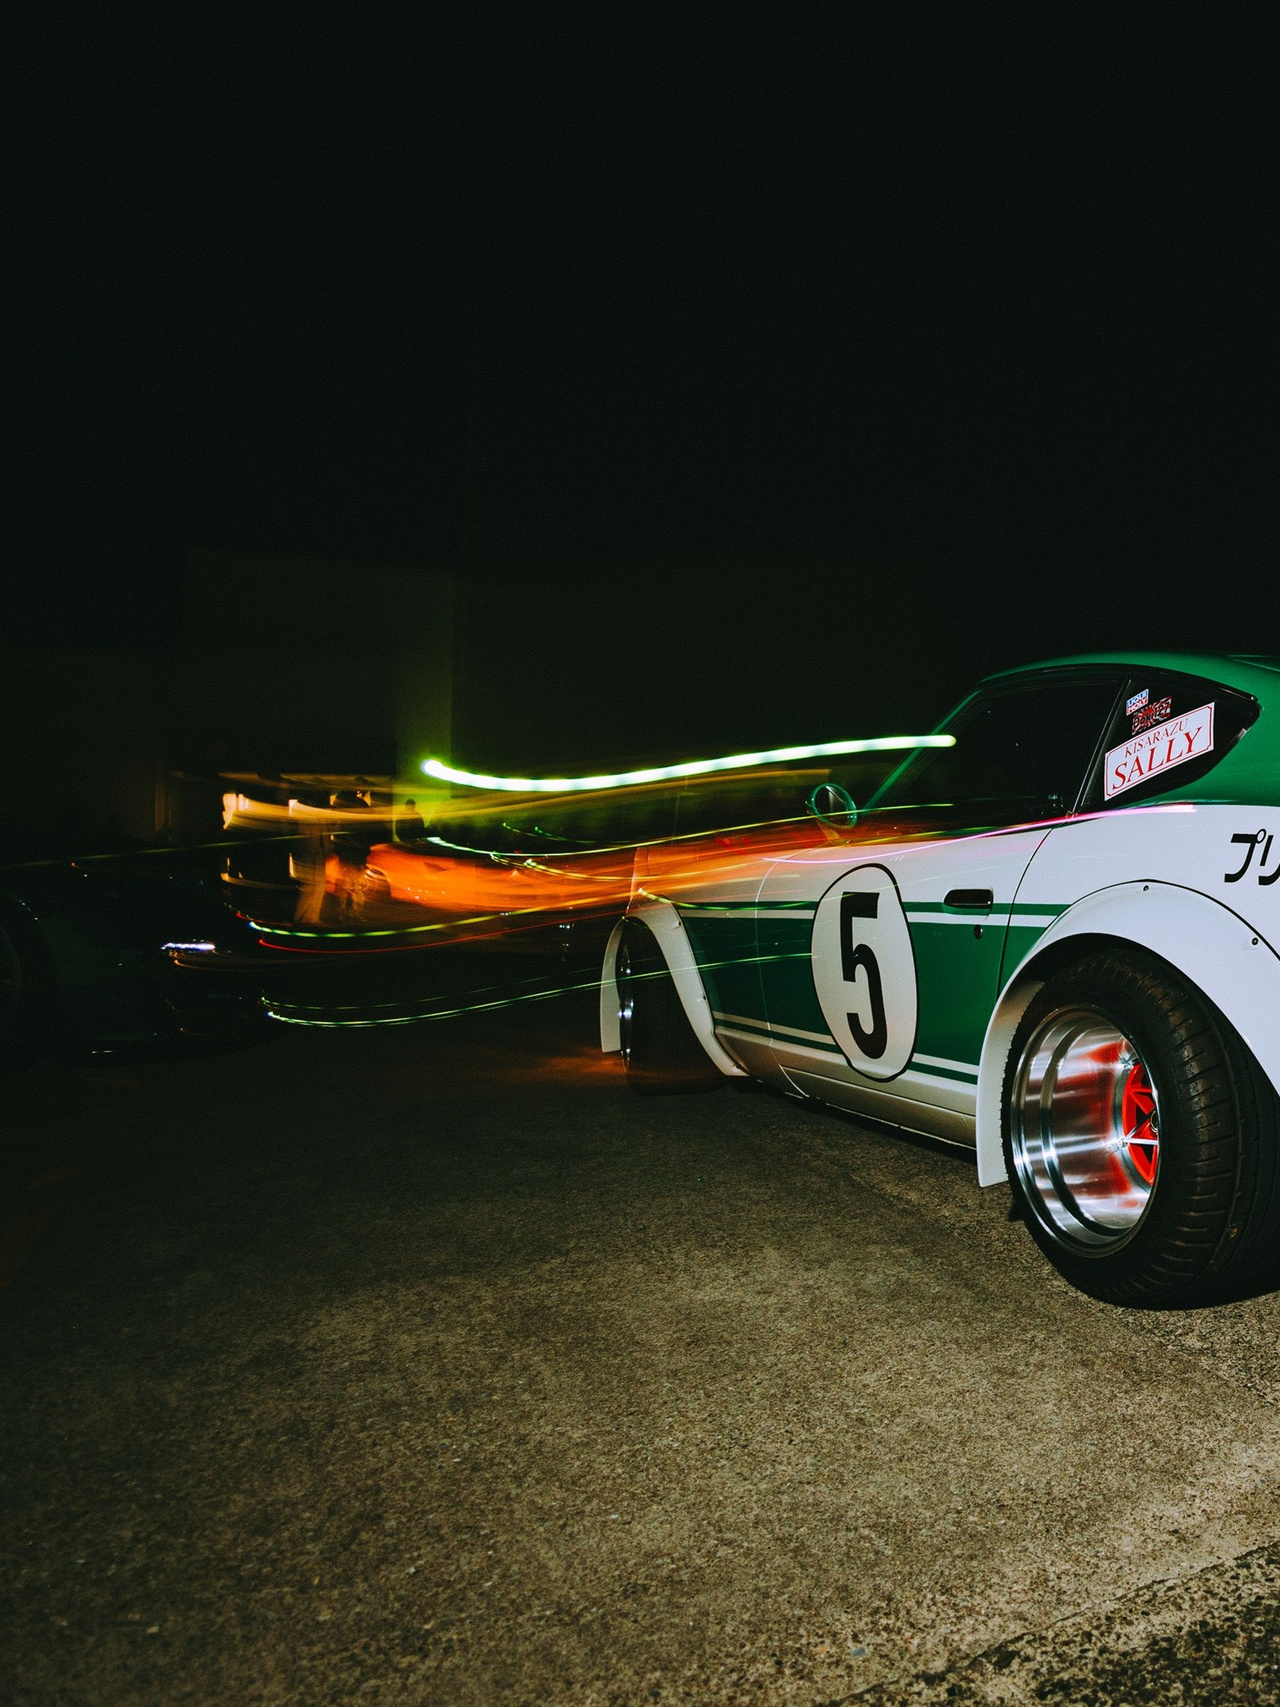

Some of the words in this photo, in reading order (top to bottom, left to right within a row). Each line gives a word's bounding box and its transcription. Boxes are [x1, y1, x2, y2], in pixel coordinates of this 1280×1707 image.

[1112, 726, 1202, 790] SALLY
[1124, 718, 1188, 758] KISARAZU
[840, 891, 888, 1060] 5
